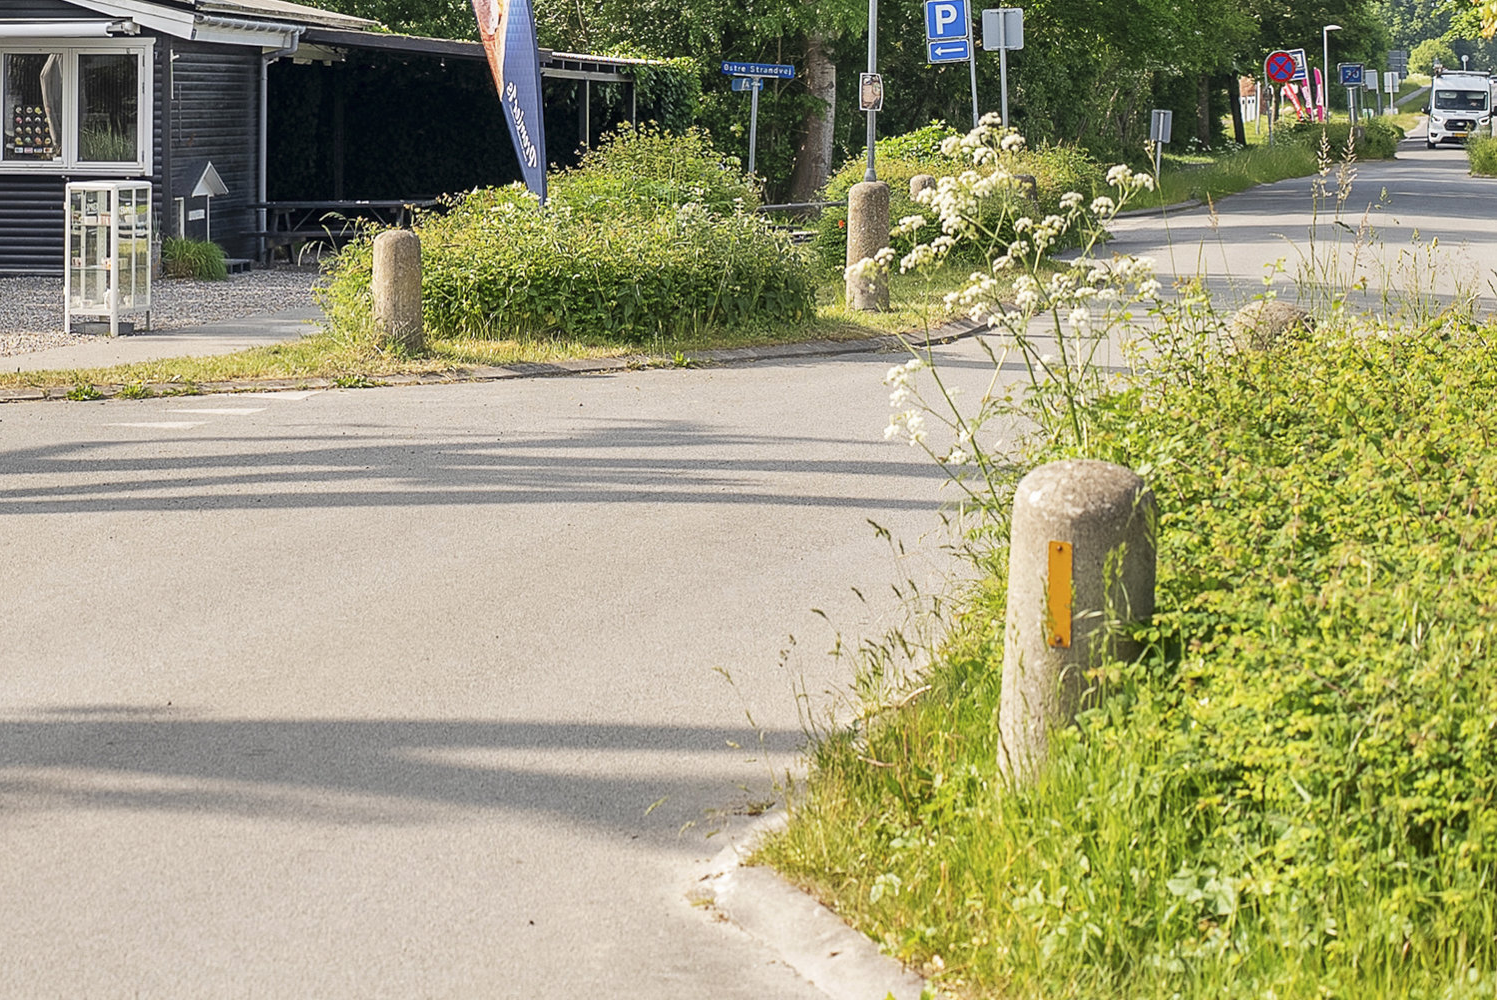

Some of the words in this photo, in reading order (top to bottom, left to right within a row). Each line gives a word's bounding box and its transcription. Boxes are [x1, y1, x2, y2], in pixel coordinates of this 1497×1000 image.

[935, 4, 957, 35] P
[723, 63, 746, 73] Østre
[749, 65, 792, 76] Strandvej
